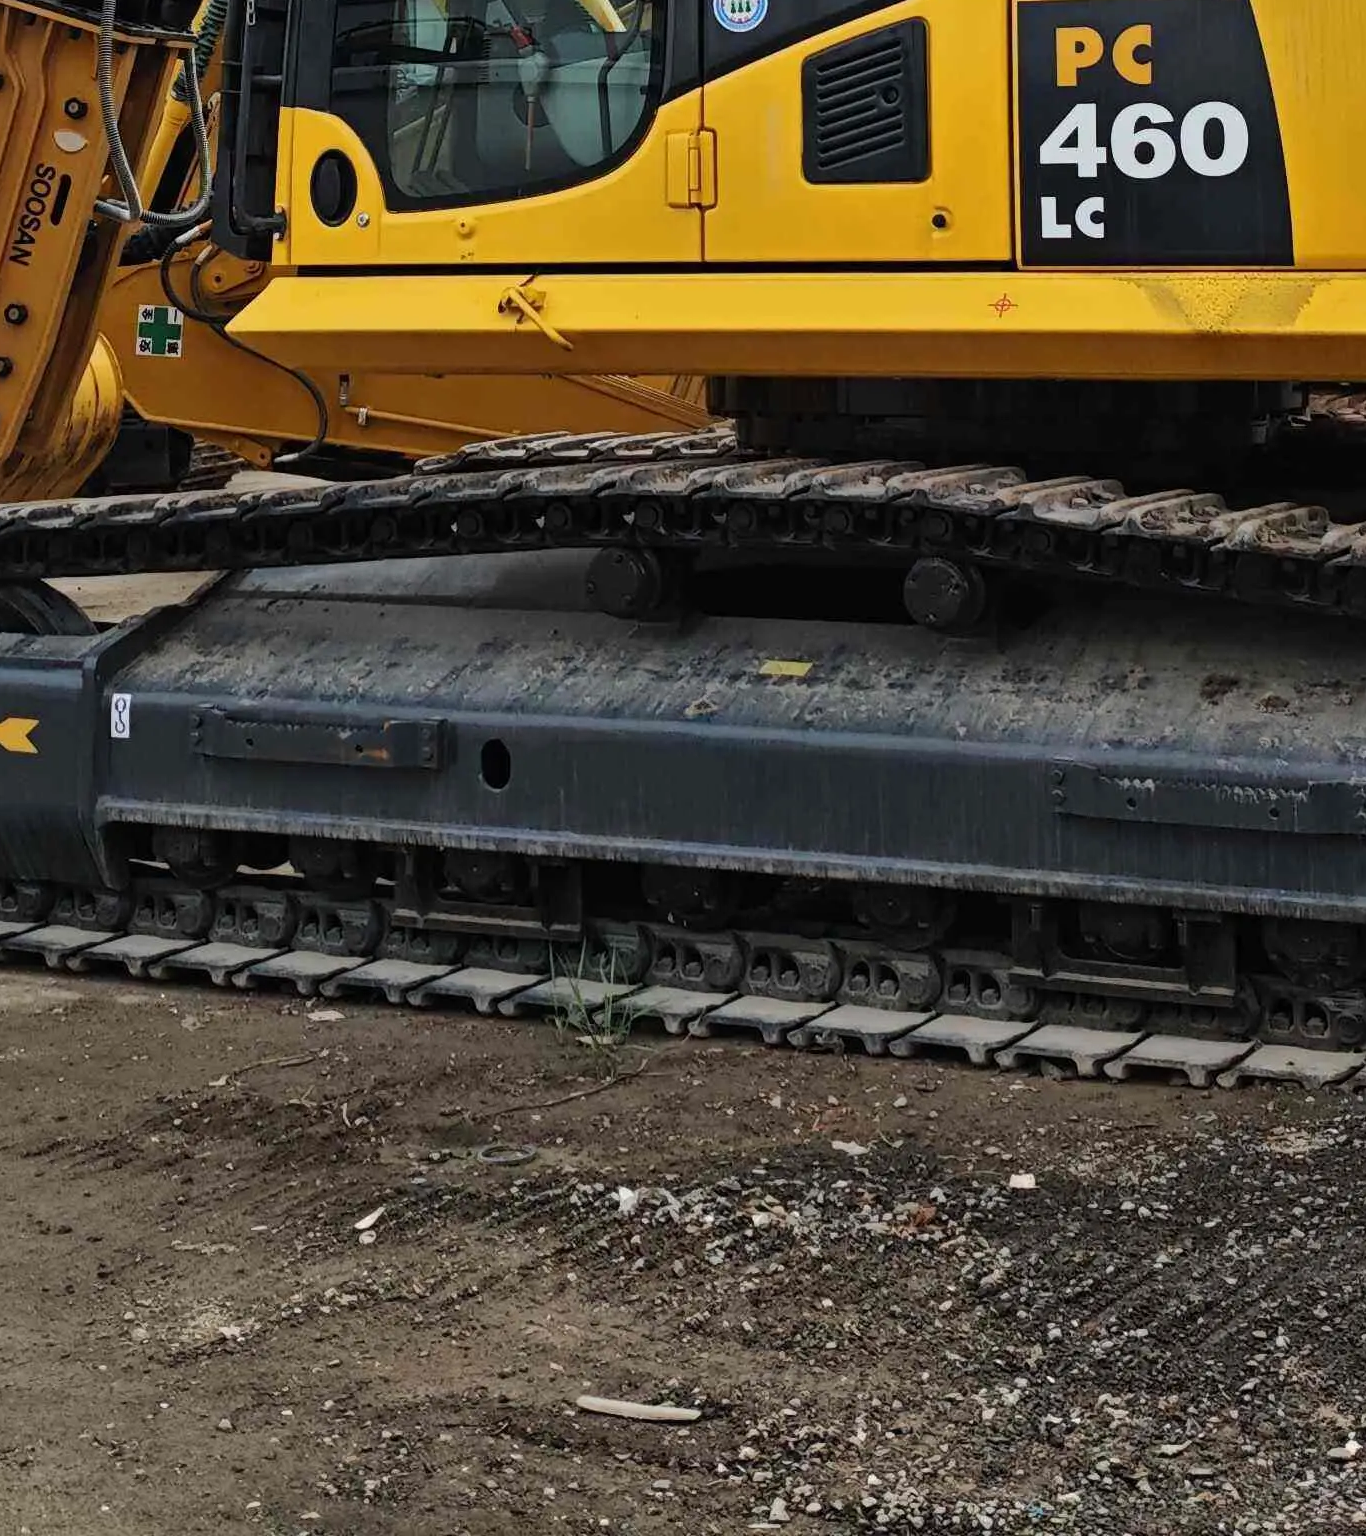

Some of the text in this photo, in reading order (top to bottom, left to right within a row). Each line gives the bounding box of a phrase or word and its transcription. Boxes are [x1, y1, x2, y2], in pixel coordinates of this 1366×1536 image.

[1055, 24, 1153, 87] PC
[1039, 101, 1250, 179] 460
[9, 163, 56, 266] SOOSAN
[1040, 196, 1106, 240] LC
